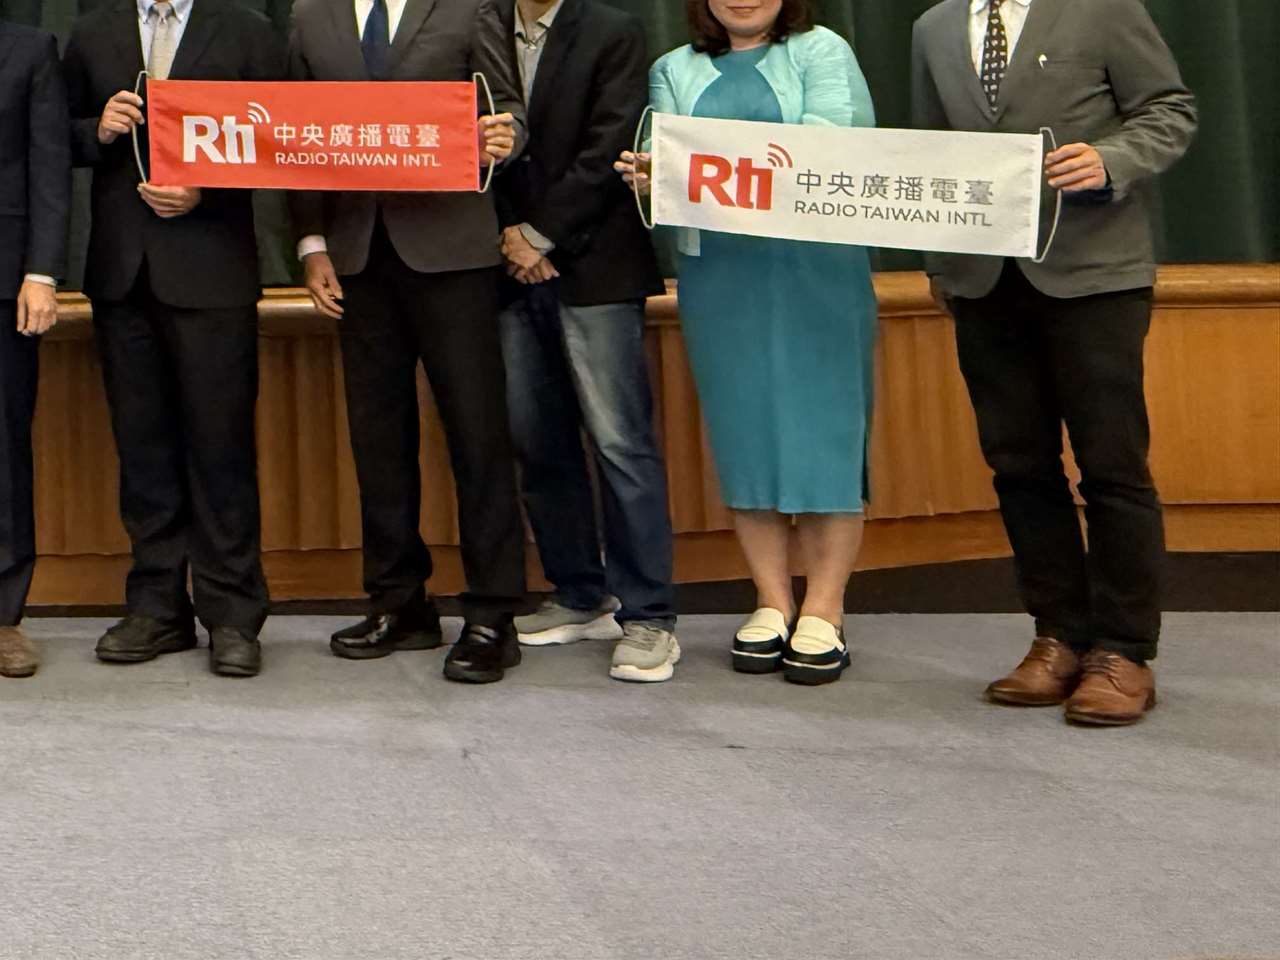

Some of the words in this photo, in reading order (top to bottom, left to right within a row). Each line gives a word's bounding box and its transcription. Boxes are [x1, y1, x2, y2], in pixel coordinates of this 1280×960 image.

[274, 123, 440, 149] 中央廣播電臺
[275, 152, 328, 166] RADIO
[332, 153, 398, 167] TAIWAN
[402, 154, 440, 168] INTL
[795, 168, 995, 206] 中央廣播電臺
[794, 200, 858, 218] RADIO
[860, 205, 940, 224] TAIWAN
[947, 210, 993, 228] INTL
